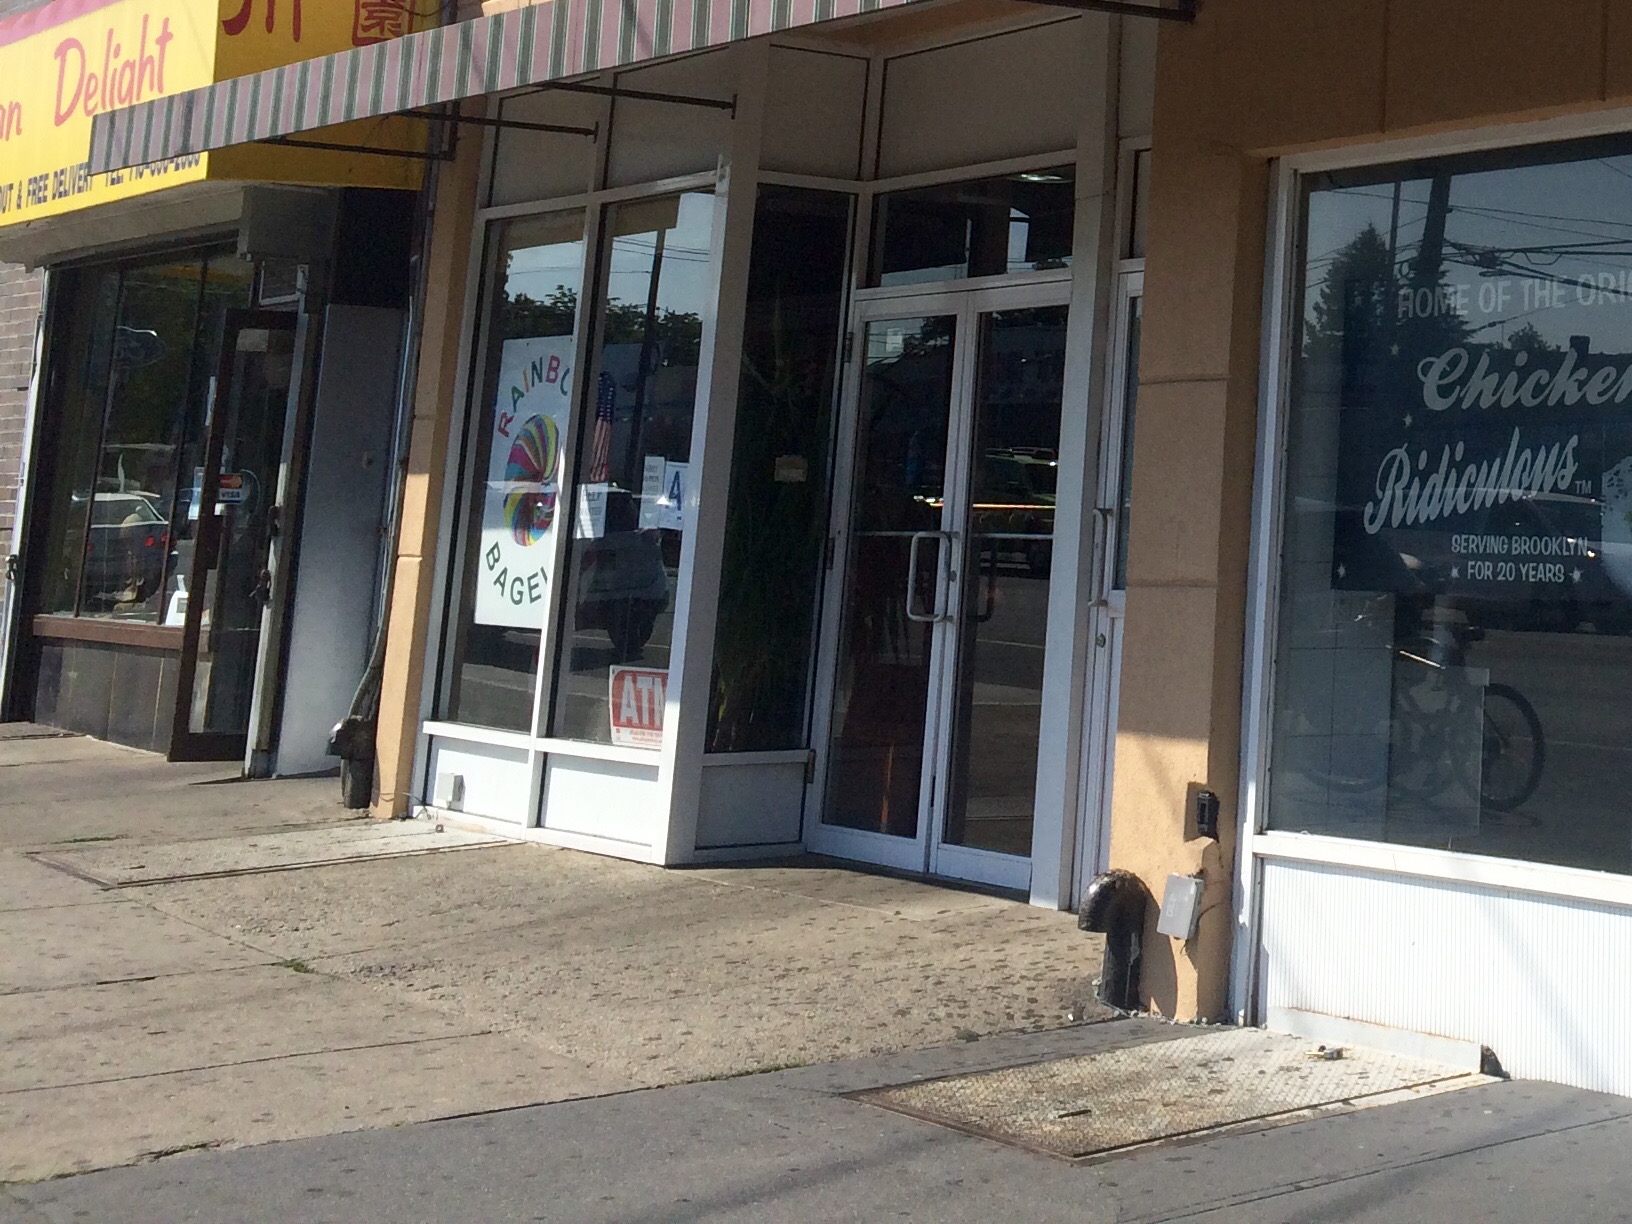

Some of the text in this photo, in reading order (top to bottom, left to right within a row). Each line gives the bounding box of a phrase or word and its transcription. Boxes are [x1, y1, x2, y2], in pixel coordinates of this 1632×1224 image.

[54, 13, 174, 127] Delight
[26, 173, 49, 207] FREE
[1397, 283, 1470, 319] HOME
[1478, 280, 1512, 314] OF
[1520, 277, 1566, 311] THE
[1363, 426, 1579, 535] Ridiculous
[1451, 534, 1588, 556] SERVING BROOKLYN
[1467, 561, 1565, 583] FOR 20 YEARS
